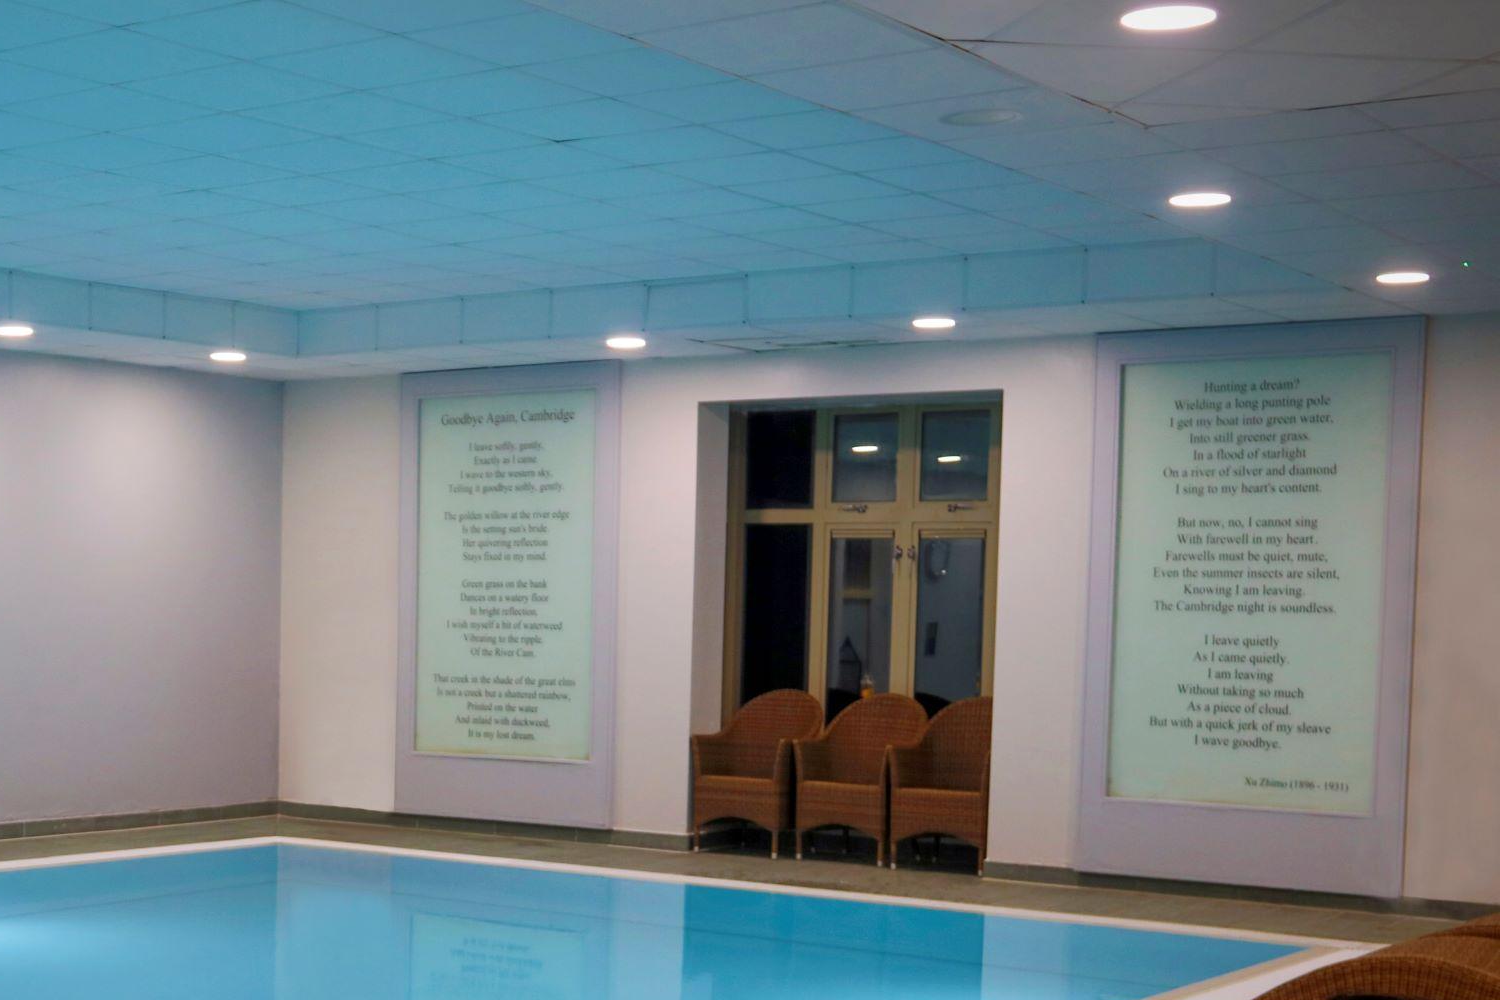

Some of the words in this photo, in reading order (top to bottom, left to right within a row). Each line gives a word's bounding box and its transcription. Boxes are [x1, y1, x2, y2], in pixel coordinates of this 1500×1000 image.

[1204, 381, 1248, 394] Hunting
[1251, 383, 1257, 391] a
[1260, 378, 1300, 391] dream?
[1174, 399, 1222, 411] Wielding
[1225, 401, 1231, 409] a
[1235, 398, 1259, 411] long
[1262, 397, 1303, 410] punting
[1306, 395, 1331, 409] pole
[441, 413, 483, 428] Goodbye
[520, 408, 575, 423] Cambridge
[1176, 418, 1193, 430] get
[1196, 419, 1211, 429] my
[1216, 415, 1239, 426] boat
[1242, 415, 1263, 425] into
[1266, 416, 1296, 427] green
[1190, 433, 1211, 444] Into
[1213, 432, 1234, 443] still
[1236, 433, 1277, 445] greener
[1193, 450, 1204, 461] In
[1217, 449, 1244, 460] flood
[1247, 449, 1260, 459] of
[1262, 449, 1306, 461] starlight
[1163, 466, 1179, 478] On
[1182, 470, 1189, 478] a
[1191, 468, 1215, 477] river
[1219, 466, 1231, 477] of
[1233, 466, 1262, 477] silver
[1266, 464, 1286, 476] and
[1288, 463, 1337, 476] diamond
[1183, 484, 1205, 497] sing
[1207, 485, 1218, 494] to
[1221, 486, 1238, 496] my
[1177, 517, 1196, 528] But
[1255, 518, 1291, 527] cannot
[1295, 517, 1318, 529] sing
[1177, 533, 1202, 545] With
[1206, 533, 1248, 545] farewell
[1252, 534, 1262, 544] in
[1266, 536, 1282, 547] my
[1165, 550, 1215, 562] Farewells
[1219, 551, 1244, 561] must
[1248, 550, 1260, 561] be
[1153, 567, 1179, 578] Even
[1182, 567, 1198, 578] the
[1201, 569, 1243, 579] summer
[1247, 568, 1283, 579] insects
[1287, 571, 1303, 579] are
[1307, 568, 1340, 580] silent,
[1183, 584, 1232, 597] Knowing
[1243, 587, 1259, 595] am
[1154, 600, 1173, 611] The
[1176, 601, 1234, 614] Cambridge
[1237, 602, 1265, 615] night
[1268, 602, 1277, 612] is
[1212, 634, 1240, 646] leave
[1242, 635, 1279, 650] quietly
[1194, 651, 1208, 662] As
[1218, 654, 1246, 663] came
[1214, 670, 1230, 679] am
[1235, 669, 1274, 683] leaving
[1177, 683, 1219, 695] Without
[1222, 684, 1255, 700] taking
[1258, 689, 1271, 697] so
[1274, 687, 1304, 699] much
[1187, 701, 1201, 712] As
[1213, 702, 1242, 715] piece
[1244, 703, 1257, 713] of
[1259, 704, 1291, 716] cloud.
[1149, 716, 1168, 727] But
[1171, 718, 1193, 728] with
[1205, 719, 1234, 732] quick
[1237, 720, 1258, 733] jerk
[1261, 721, 1275, 731] of
[1276, 724, 1292, 735] my
[1296, 723, 1331, 734] sleave
[1202, 737, 1229, 746] wave
